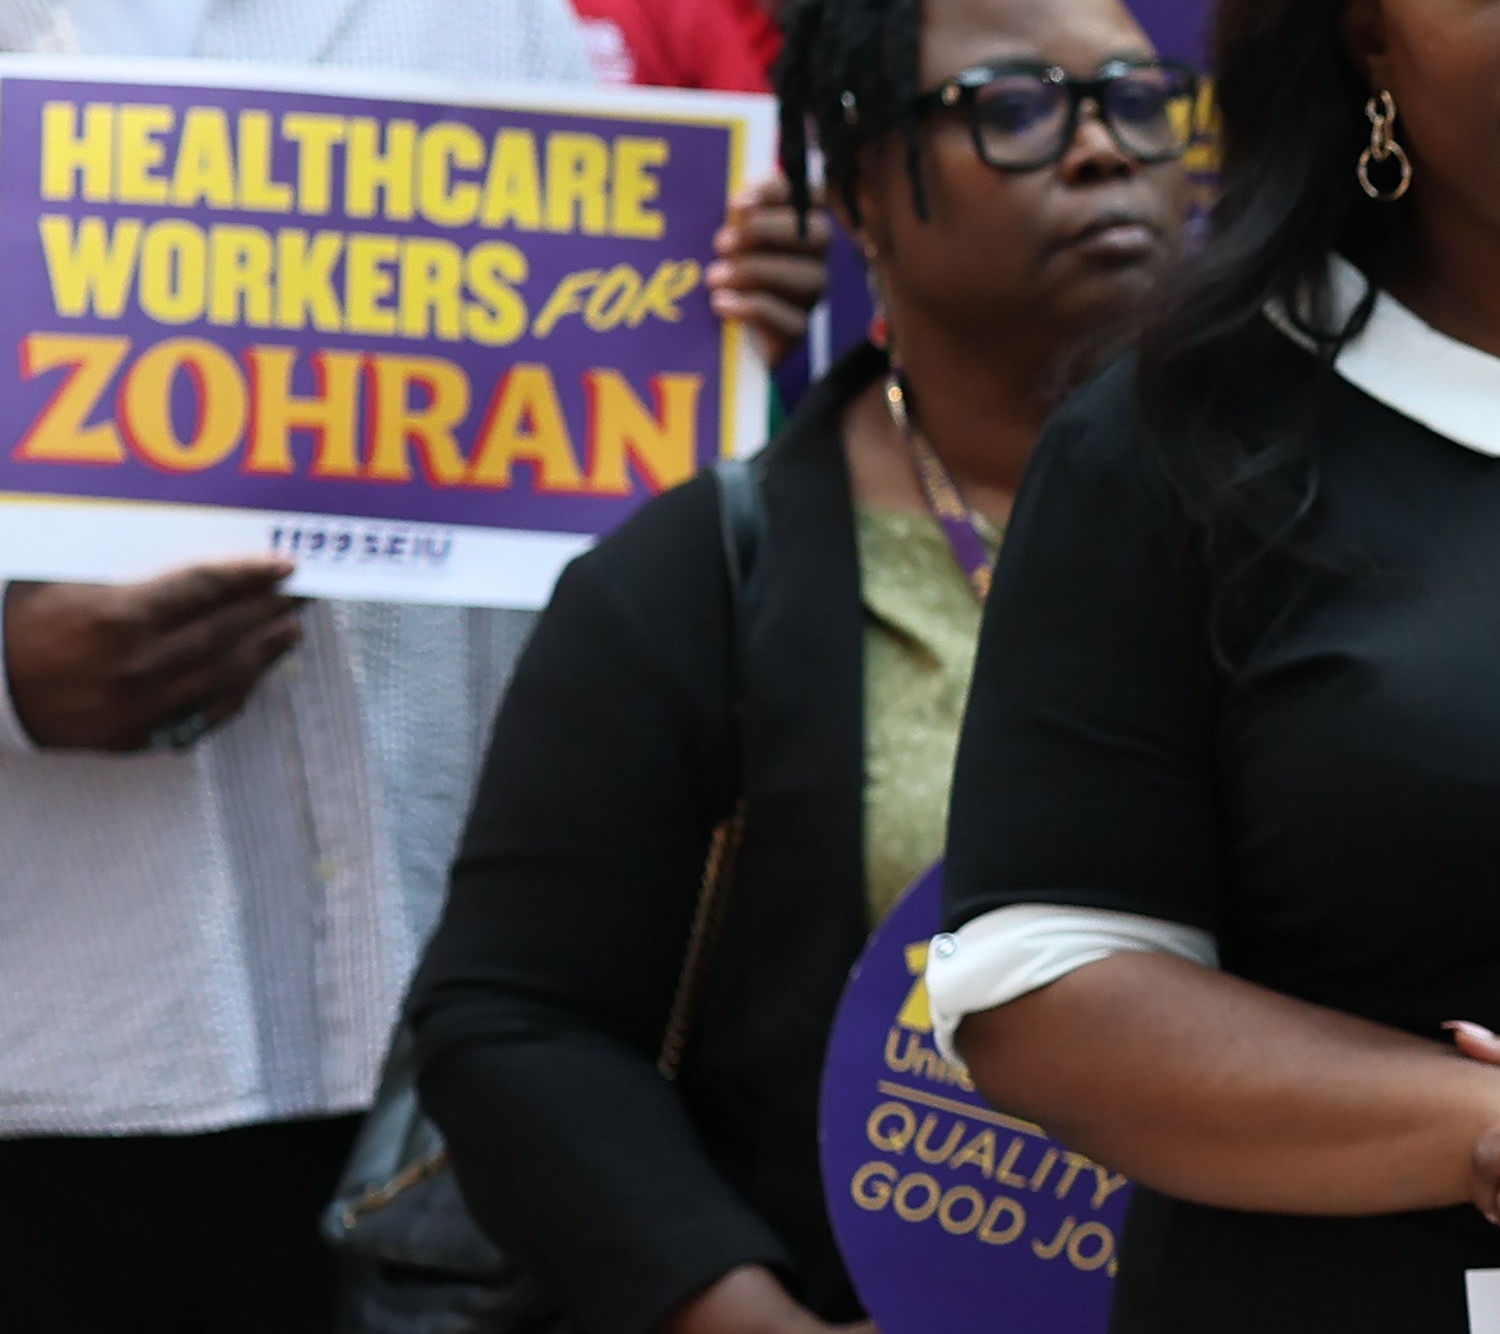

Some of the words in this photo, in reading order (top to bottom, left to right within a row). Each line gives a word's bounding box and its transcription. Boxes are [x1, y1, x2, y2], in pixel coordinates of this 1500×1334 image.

[40, 100, 669, 242] HEALTHCARE
[37, 214, 529, 347] WORKERS
[533, 257, 704, 339] FOR
[12, 331, 704, 497] ZOHRAN
[850, 1160, 1026, 1246] GOOD
[1031, 1214, 1120, 1277] JO
[865, 1100, 1128, 1209] QUALITY
